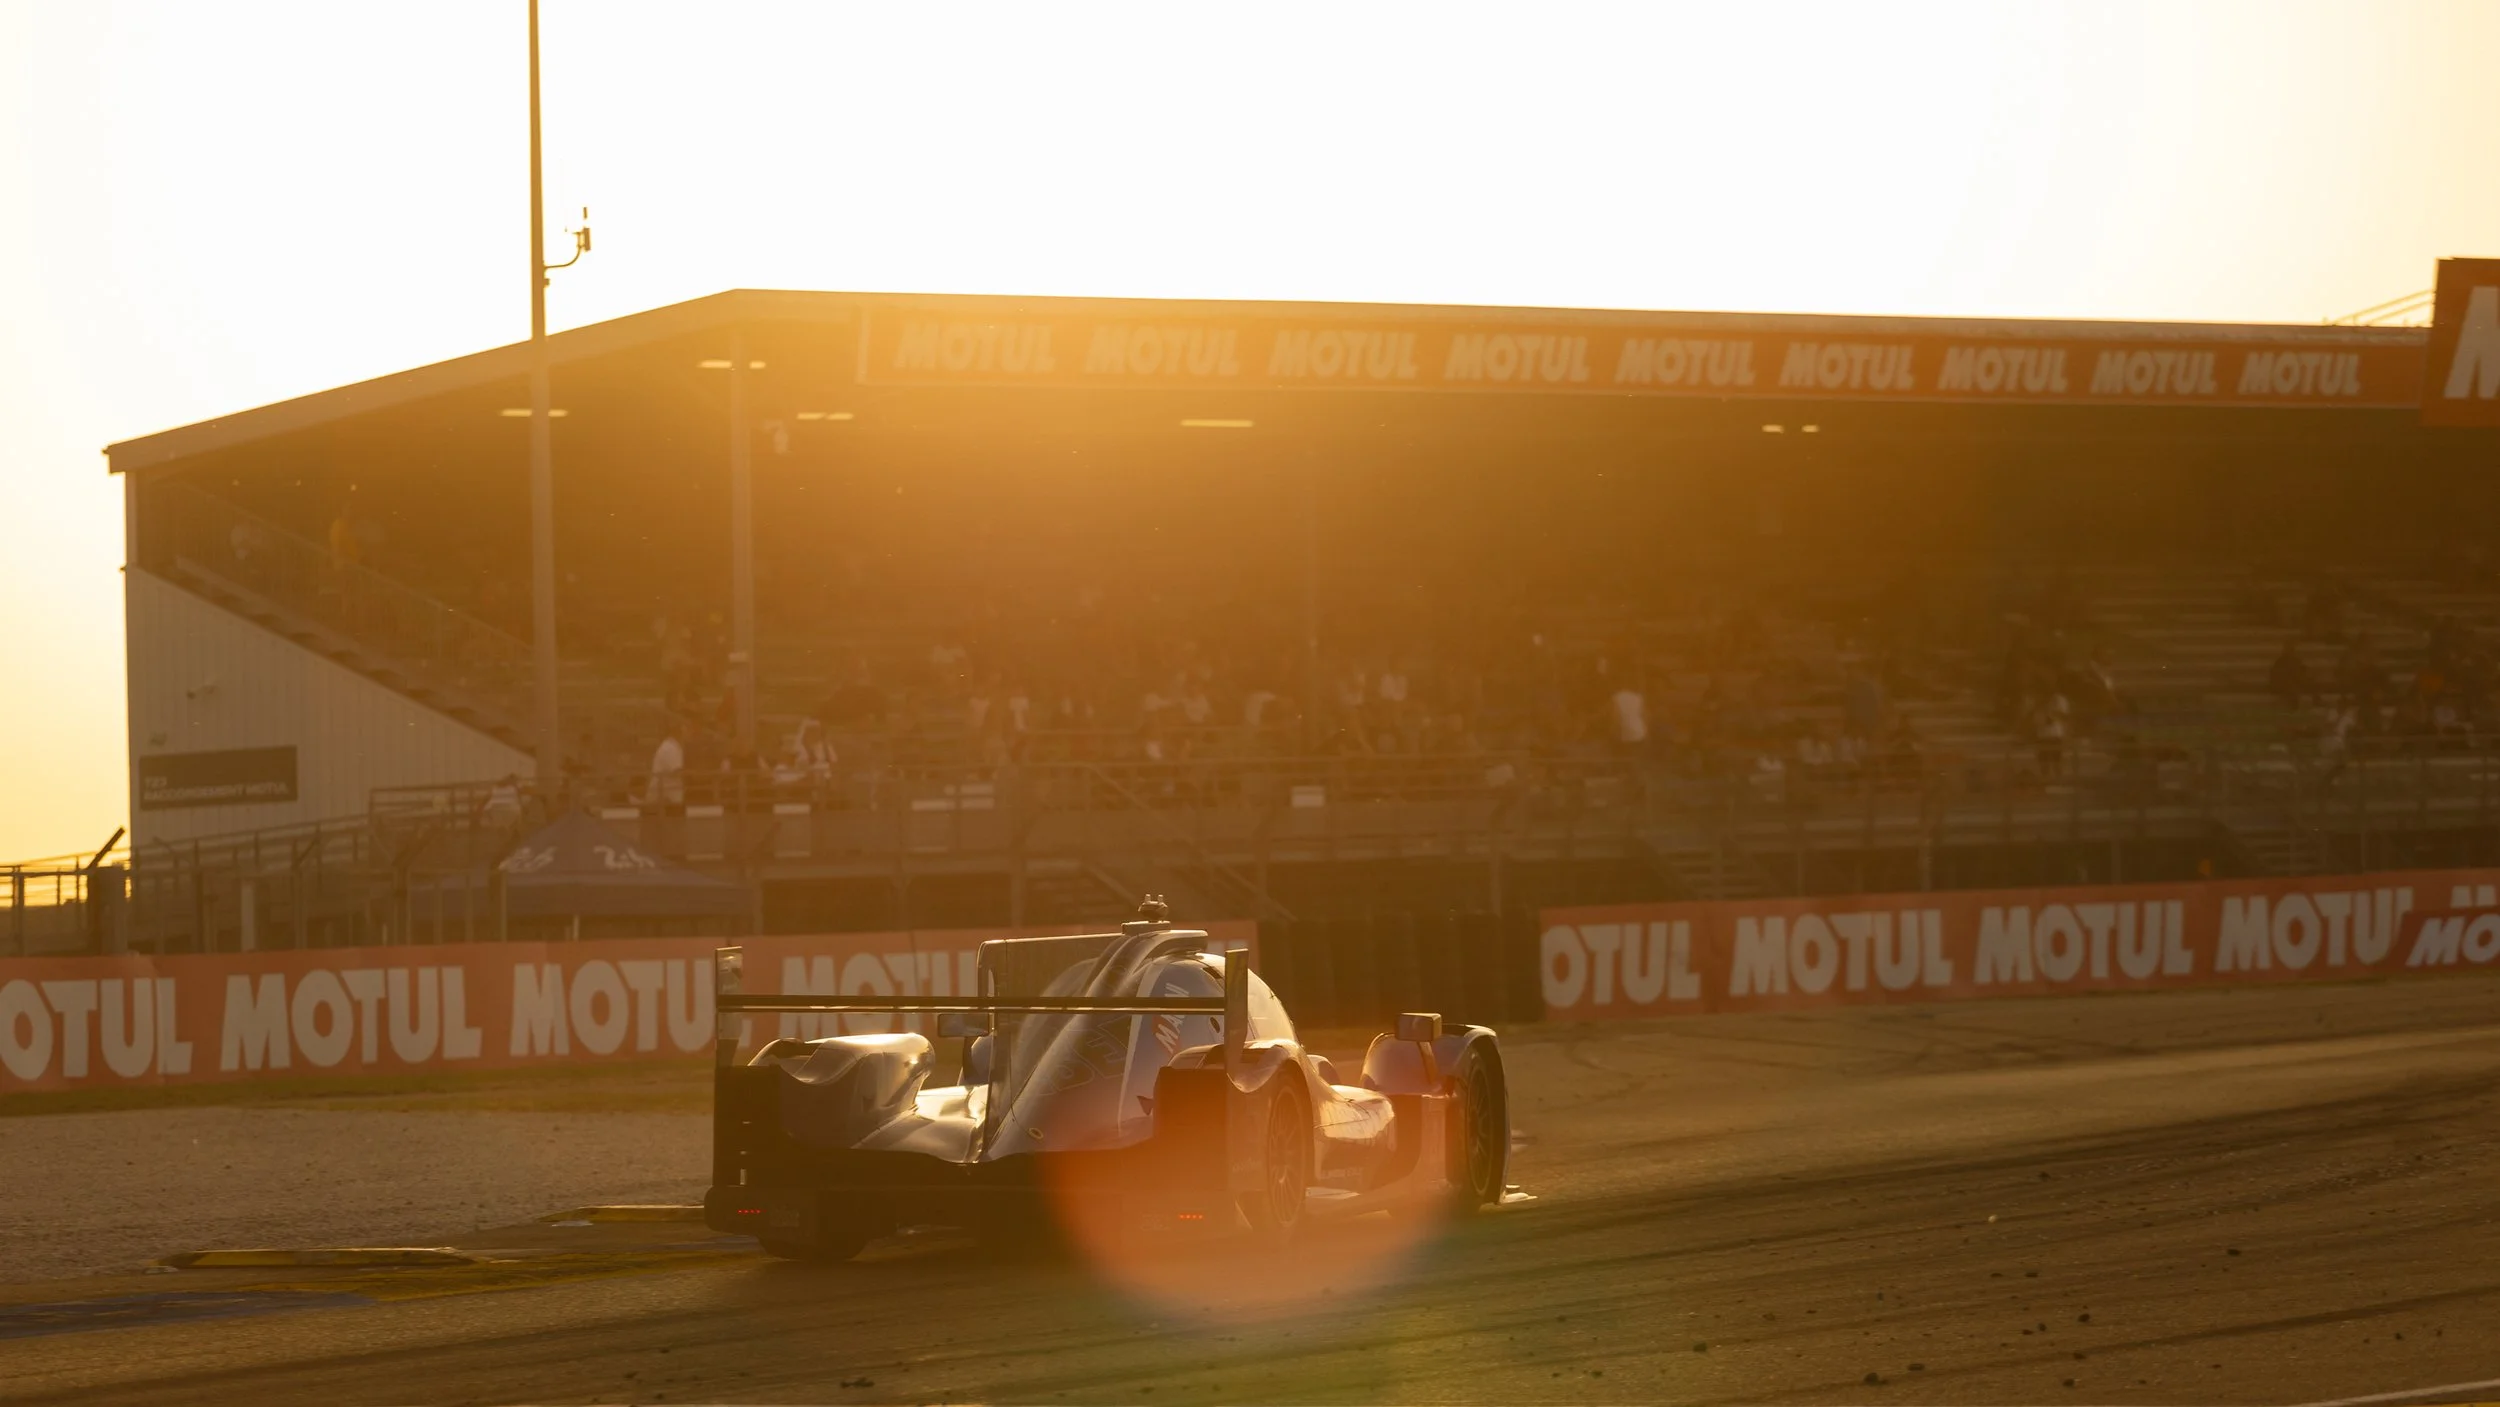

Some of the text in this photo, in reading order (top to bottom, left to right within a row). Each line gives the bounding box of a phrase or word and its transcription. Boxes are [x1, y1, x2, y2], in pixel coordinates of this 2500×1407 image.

[894, 321, 2361, 396] MOTUL MOTUL MOTUL MOTUL MOTUL MOTUL MOTUL MOTUL MOTUL
[1540, 919, 1701, 1008] OTUL
[1729, 908, 1953, 997] MOTUL
[1974, 899, 2194, 985] MOTUL
[220, 966, 482, 1070] MOTUL
[510, 956, 752, 1058] MOTU
